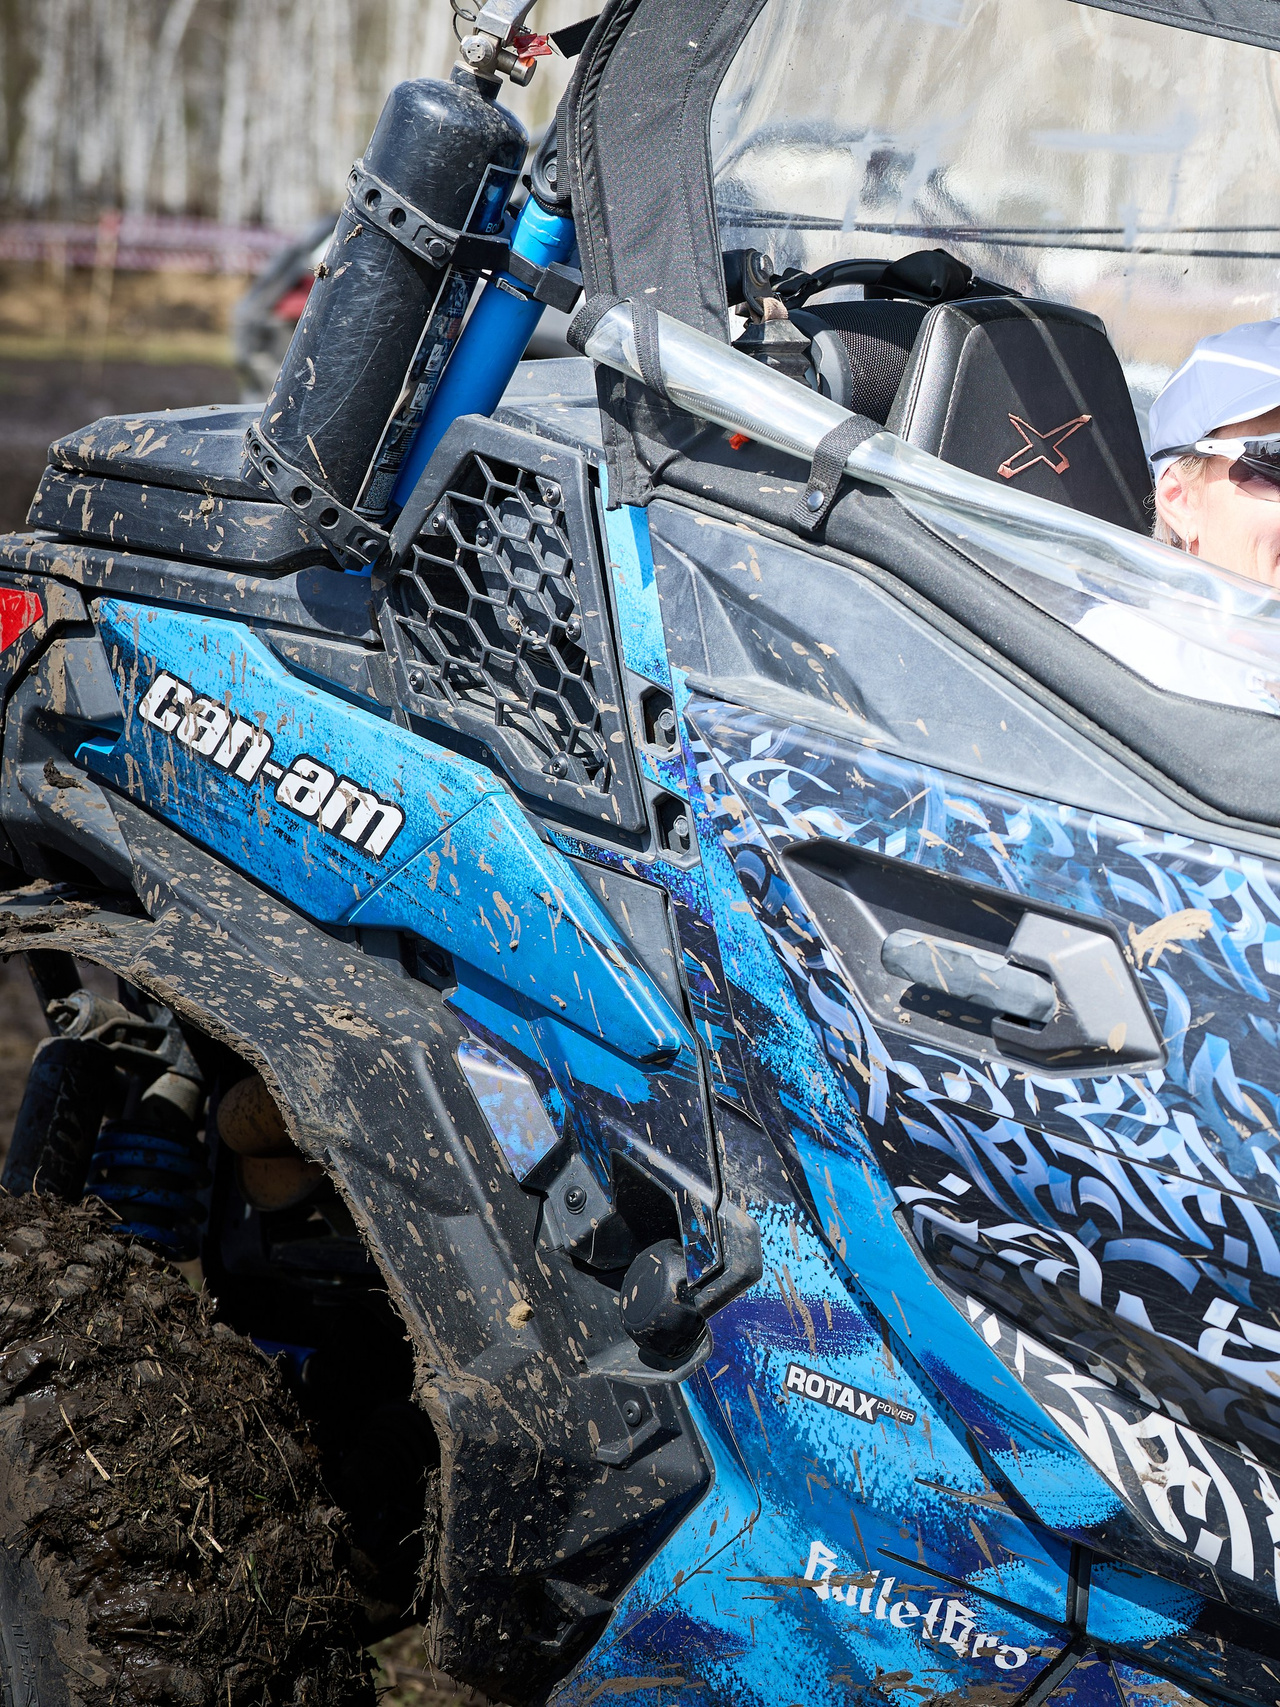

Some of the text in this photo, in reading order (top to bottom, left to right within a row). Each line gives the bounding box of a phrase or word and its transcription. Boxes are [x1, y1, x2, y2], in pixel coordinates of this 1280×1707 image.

[137, 672, 405, 859] can-am
[786, 1365, 915, 1423] ROTAX POWER
